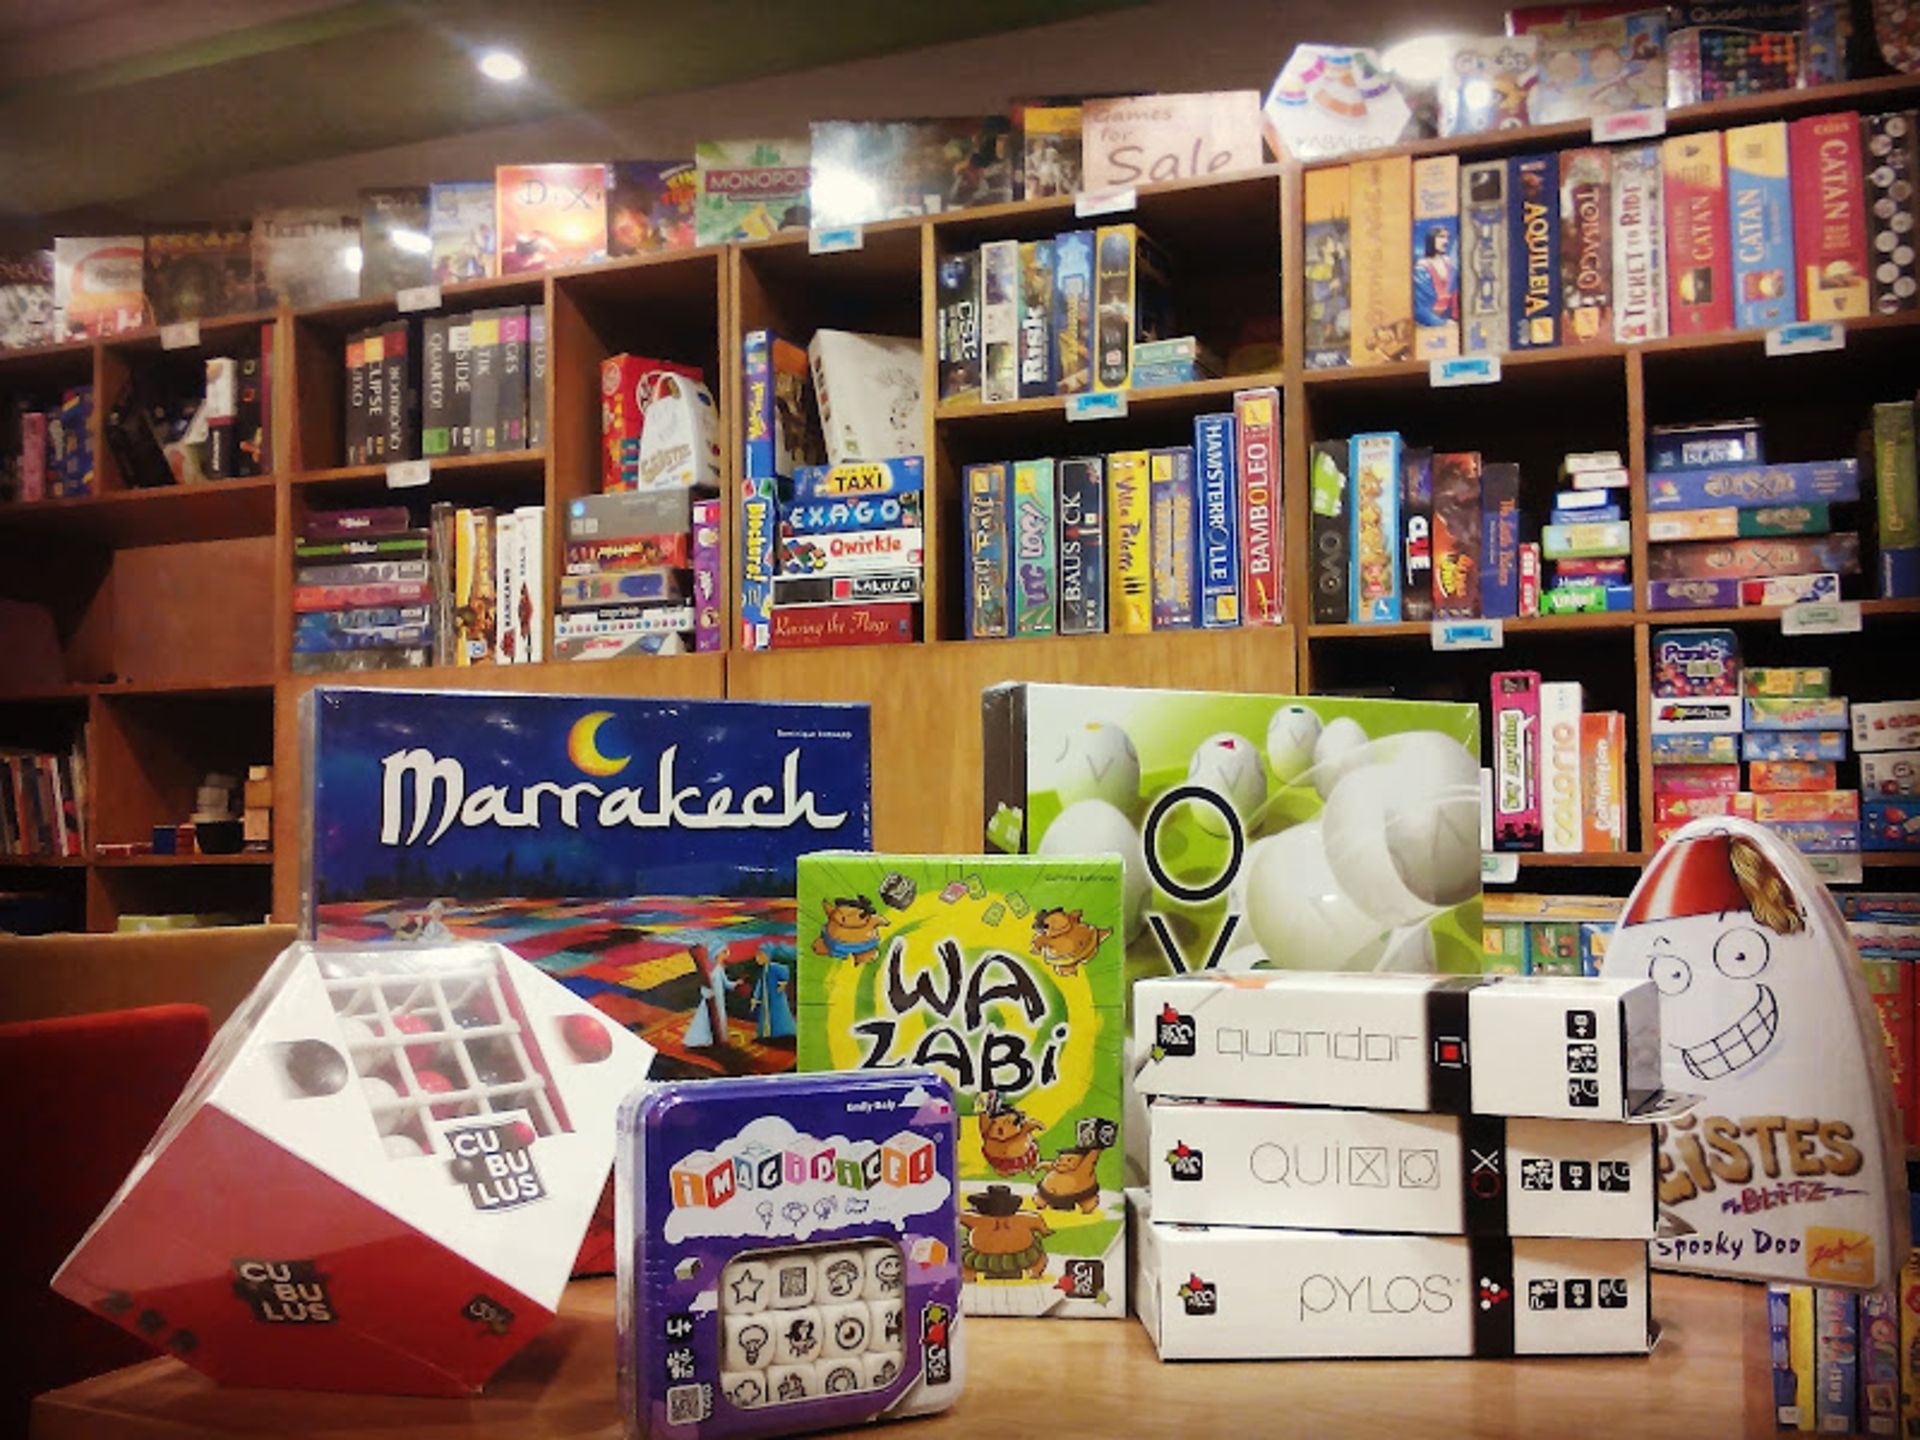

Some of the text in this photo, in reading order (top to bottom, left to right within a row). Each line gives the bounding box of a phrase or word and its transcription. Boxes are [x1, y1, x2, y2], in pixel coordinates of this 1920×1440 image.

[1107, 138, 1233, 186] Sale
[1820, 138, 1849, 221] CATAN
[1692, 197, 1714, 260] CATAN
[1738, 188, 1763, 263] CATAN
[1524, 203, 1549, 316] AQUILEIA
[1623, 252, 1647, 319] TICKET
[834, 472, 882, 493] TAXI
[789, 499, 901, 528] EXAGO
[1247, 443, 1271, 574] BAMBOLEO
[830, 534, 903, 558] Qwirkle
[380, 744, 848, 846] Marrakech
[453, 1130, 502, 1158] CU
[484, 1148, 530, 1179] BU
[476, 1175, 539, 1208] LUS
[1656, 1228, 1801, 1261] Spooky Doo
[239, 1261, 292, 1285] CU
[274, 1281, 323, 1304] BU
[262, 1301, 332, 1322] LUS
[666, 1318, 693, 1338] 4+
